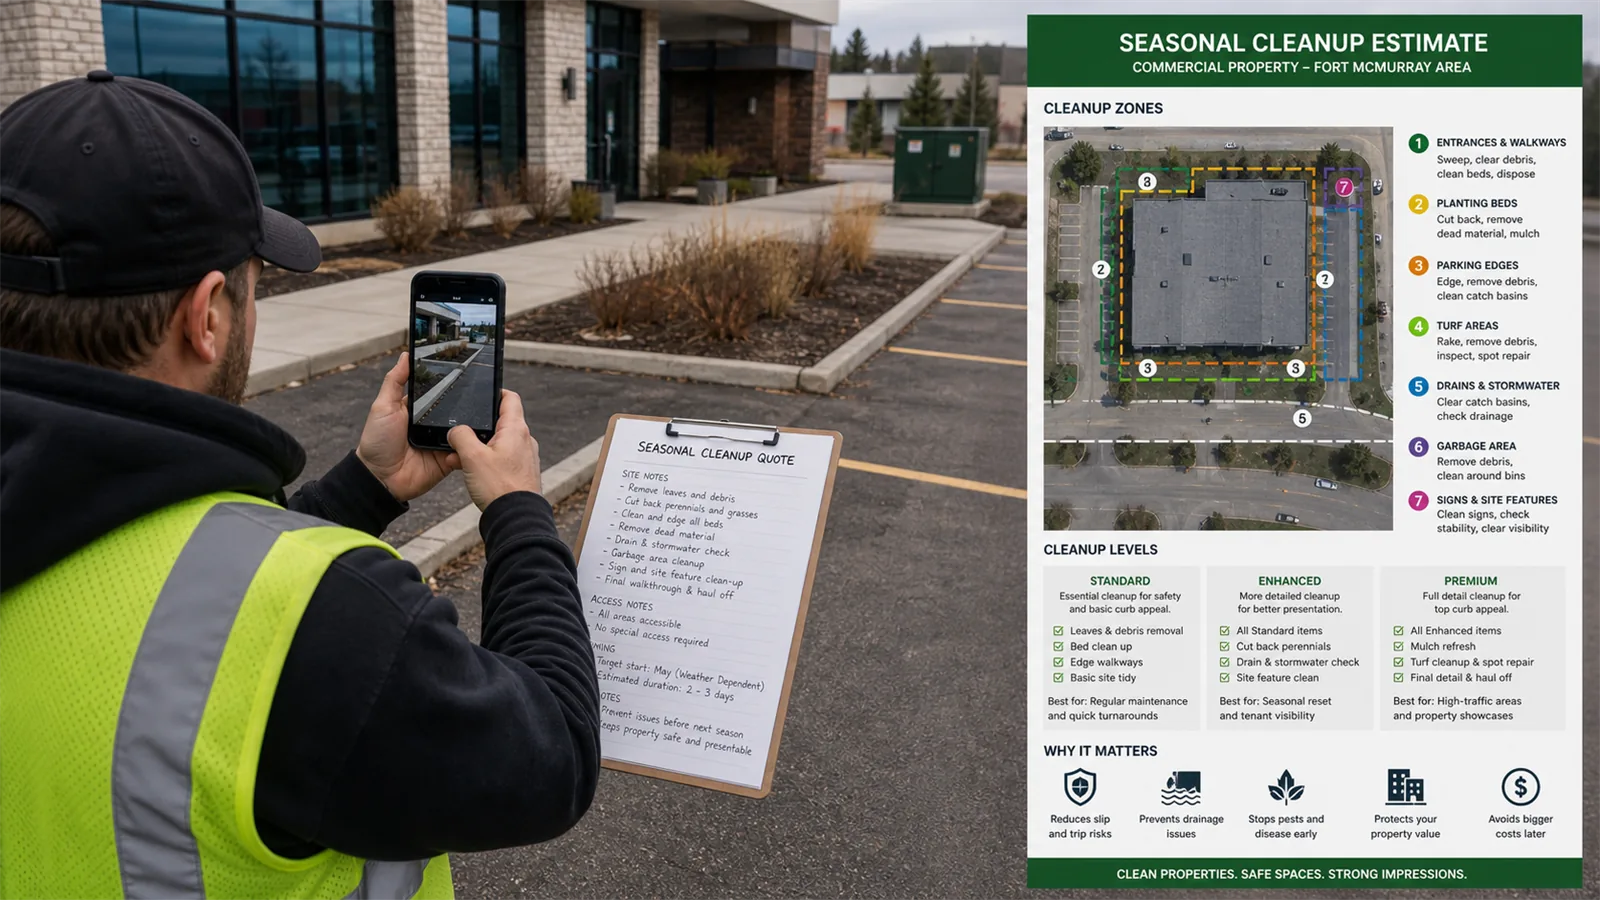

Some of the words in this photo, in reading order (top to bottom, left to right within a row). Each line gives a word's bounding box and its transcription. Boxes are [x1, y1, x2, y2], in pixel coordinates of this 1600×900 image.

[637, 440, 695, 456] SEASONAL
[700, 447, 752, 461] CLEANUP
[757, 452, 795, 465] QUOTE
[621, 469, 640, 479] SITE
[643, 472, 668, 482] NOTES
[628, 482, 658, 494] Remove
[662, 486, 686, 497] leaves
[690, 491, 706, 499] and
[709, 492, 735, 503] debris
[621, 508, 644, 519] Clean
[647, 513, 663, 521] and
[666, 515, 686, 527] edge
[689, 517, 700, 525] all
[703, 518, 723, 529] beds
[624, 495, 639, 505] Cut
[642, 498, 661, 508] back
[664, 502, 705, 513] perennials
[708, 506, 724, 515] and
[727, 510, 758, 519] grasses
[618, 521, 650, 534] Remove
[654, 526, 675, 536] dead
[678, 531, 715, 540] material
[614, 534, 637, 545] Drain
[640, 538, 647, 547] &
[651, 540, 700, 553] stormwater
[704, 546, 729, 557] check
[611, 547, 645, 563] Garbage
[649, 555, 668, 563] area
[671, 556, 704, 570] cleanup
[607, 560, 626, 574] Sign
[630, 566, 647, 574] and
[651, 568, 666, 577] site
[670, 569, 701, 582] feature
[705, 574, 743, 589] clean-up
[604, 574, 626, 585] Final
[629, 579, 681, 595] walkthrough
[685, 585, 692, 595] &
[696, 587, 716, 597] haul
[719, 589, 734, 599] off
[590, 594, 622, 607] ACCESS
[626, 600, 652, 611] NOTES
[597, 608, 610, 619] All
[612, 613, 635, 623] areas
[639, 617, 681, 629] accessible
[594, 622, 607, 632] No
[609, 626, 639, 636] special
[642, 631, 669, 642] access
[673, 636, 709, 647] required
